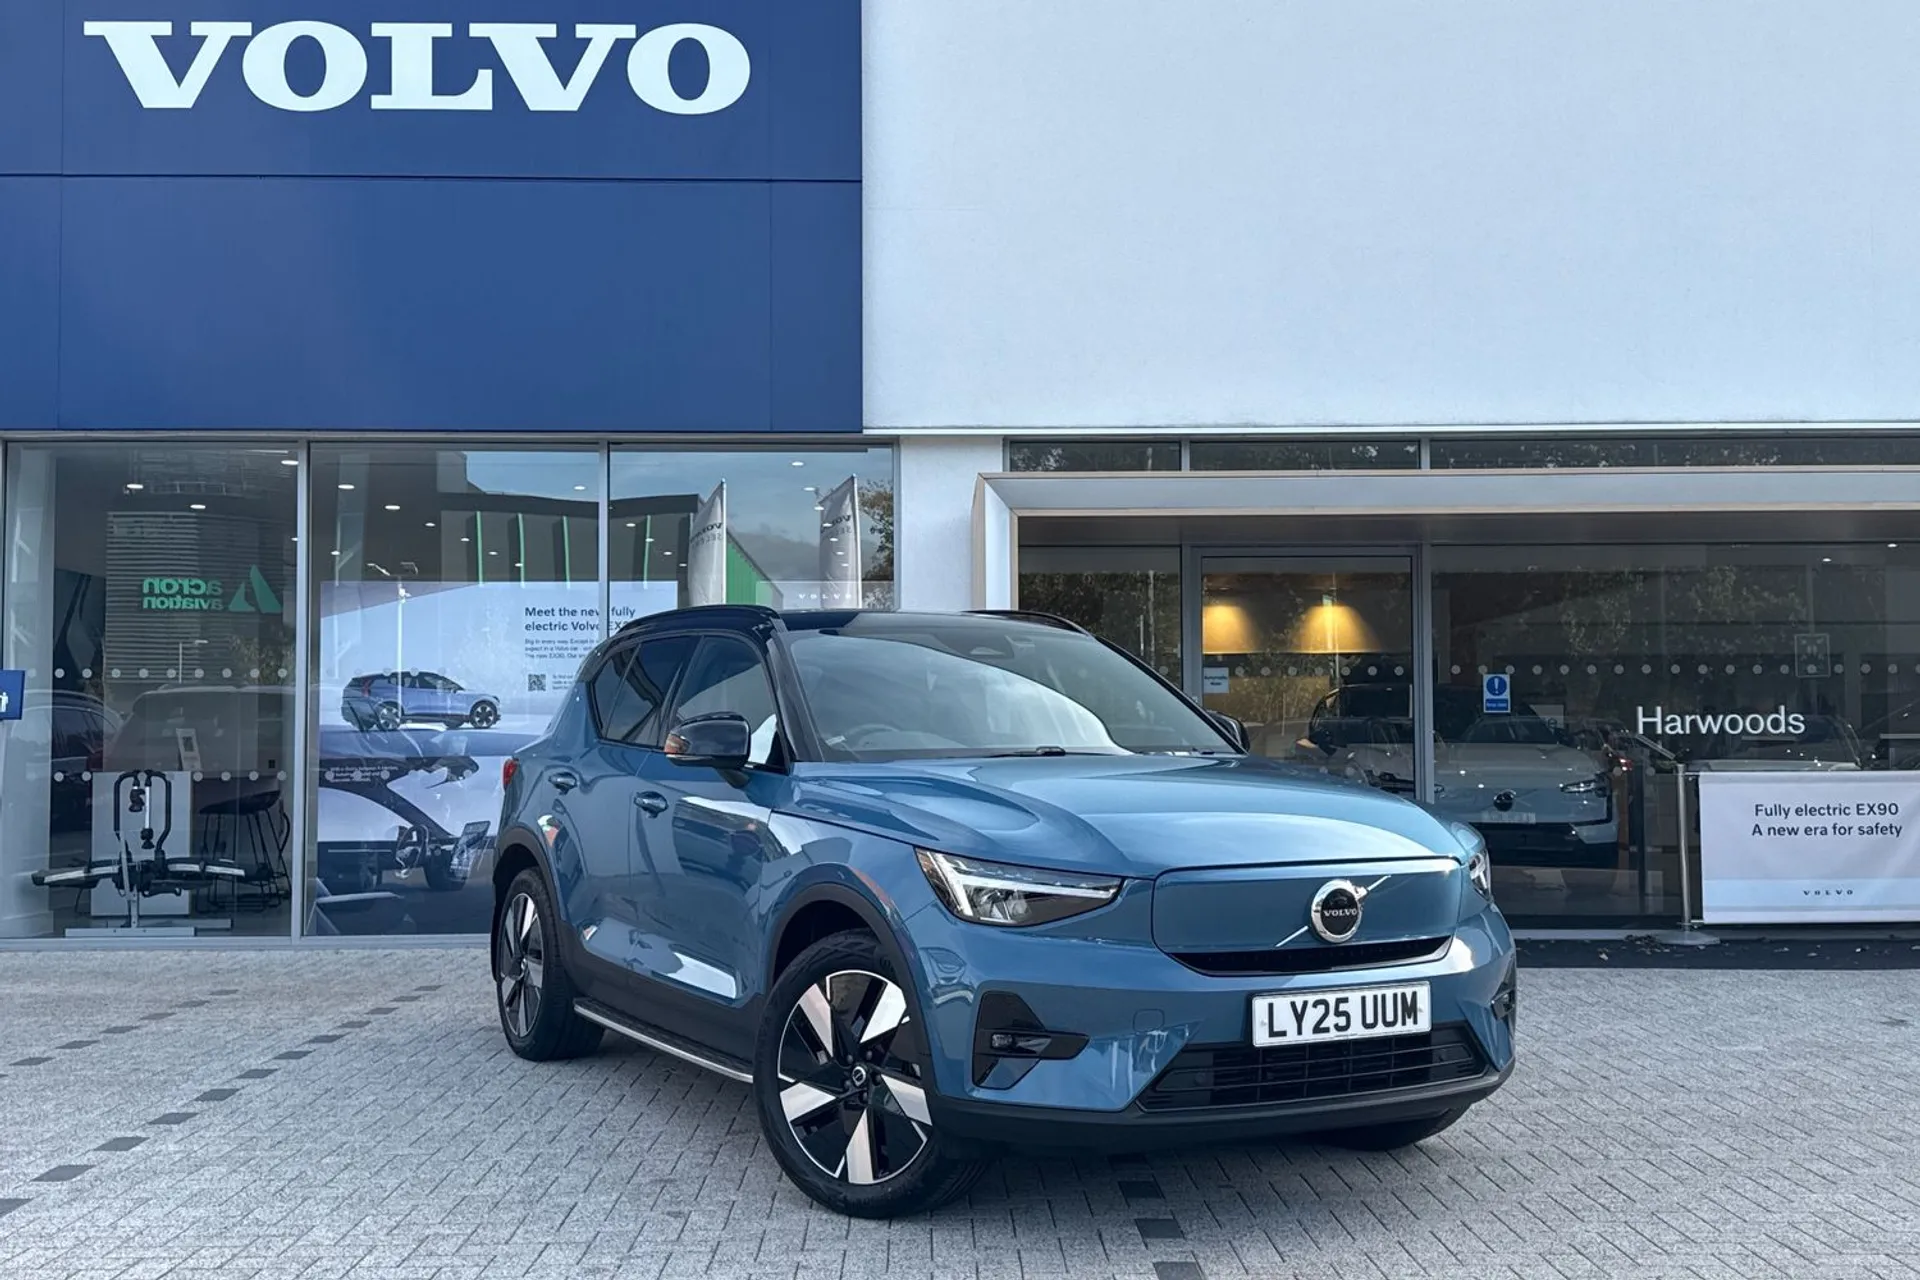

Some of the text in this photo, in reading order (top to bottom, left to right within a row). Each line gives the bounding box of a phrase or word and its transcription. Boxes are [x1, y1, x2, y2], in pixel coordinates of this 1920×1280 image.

[83, 20, 751, 115] VOLVO
[524, 606, 555, 617] Meet
[559, 606, 578, 617] the
[611, 606, 636, 618] fully
[524, 621, 568, 631] electric
[1636, 705, 1806, 735] Harwoods
[1754, 802, 1900, 819] Fully electric EX90
[1751, 822, 1904, 838] A new era for safety
[1323, 907, 1358, 917] VOLVO
[1267, 990, 1419, 1039] LY25 UUM
